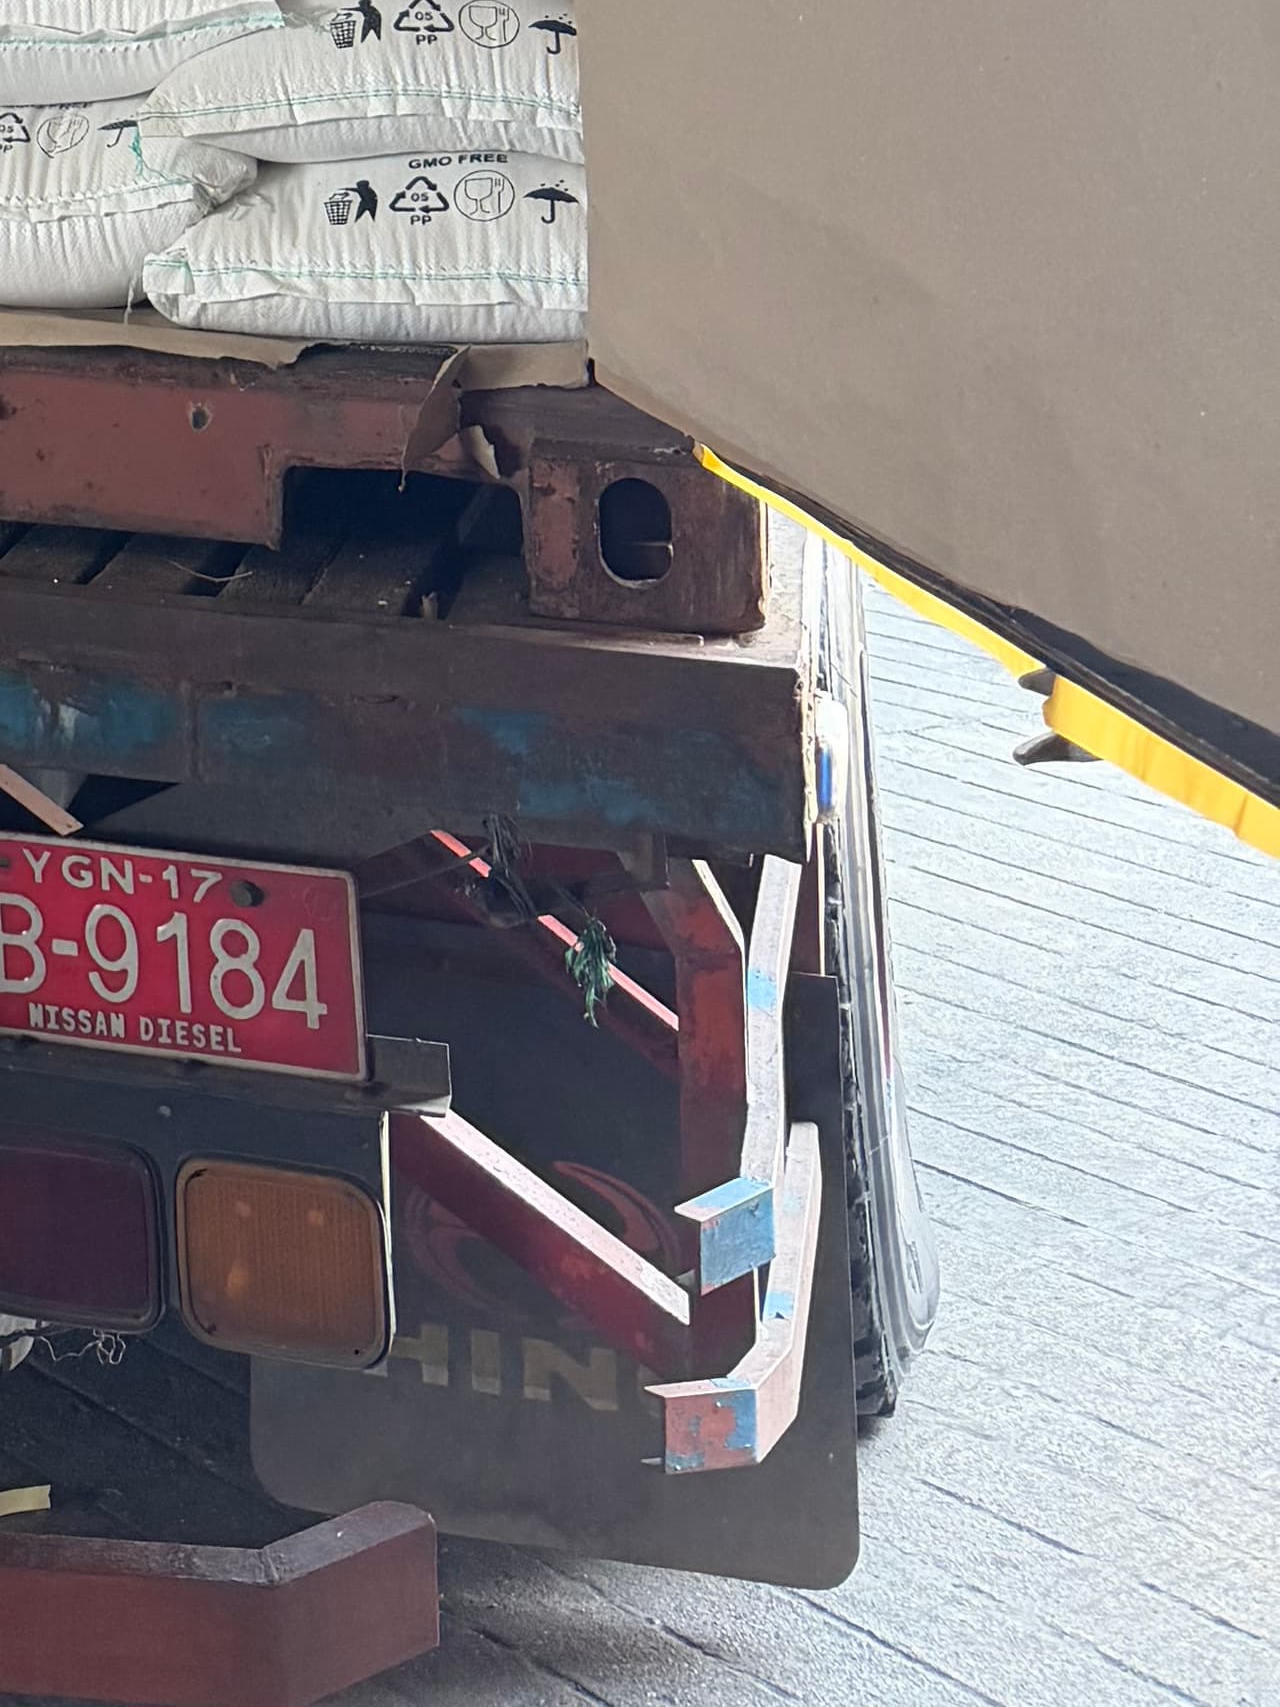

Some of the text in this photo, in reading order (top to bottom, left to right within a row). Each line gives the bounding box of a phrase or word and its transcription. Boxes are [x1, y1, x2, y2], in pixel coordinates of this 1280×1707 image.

[415, 11, 433, 21] 05
[416, 34, 438, 45] PP
[409, 153, 508, 169] GMO FREE
[411, 193, 429, 202] 05
[410, 215, 432, 225] PP
[21, 847, 224, 904] YGN-17
[27, 1002, 242, 1054] NISSAN DIESEL
